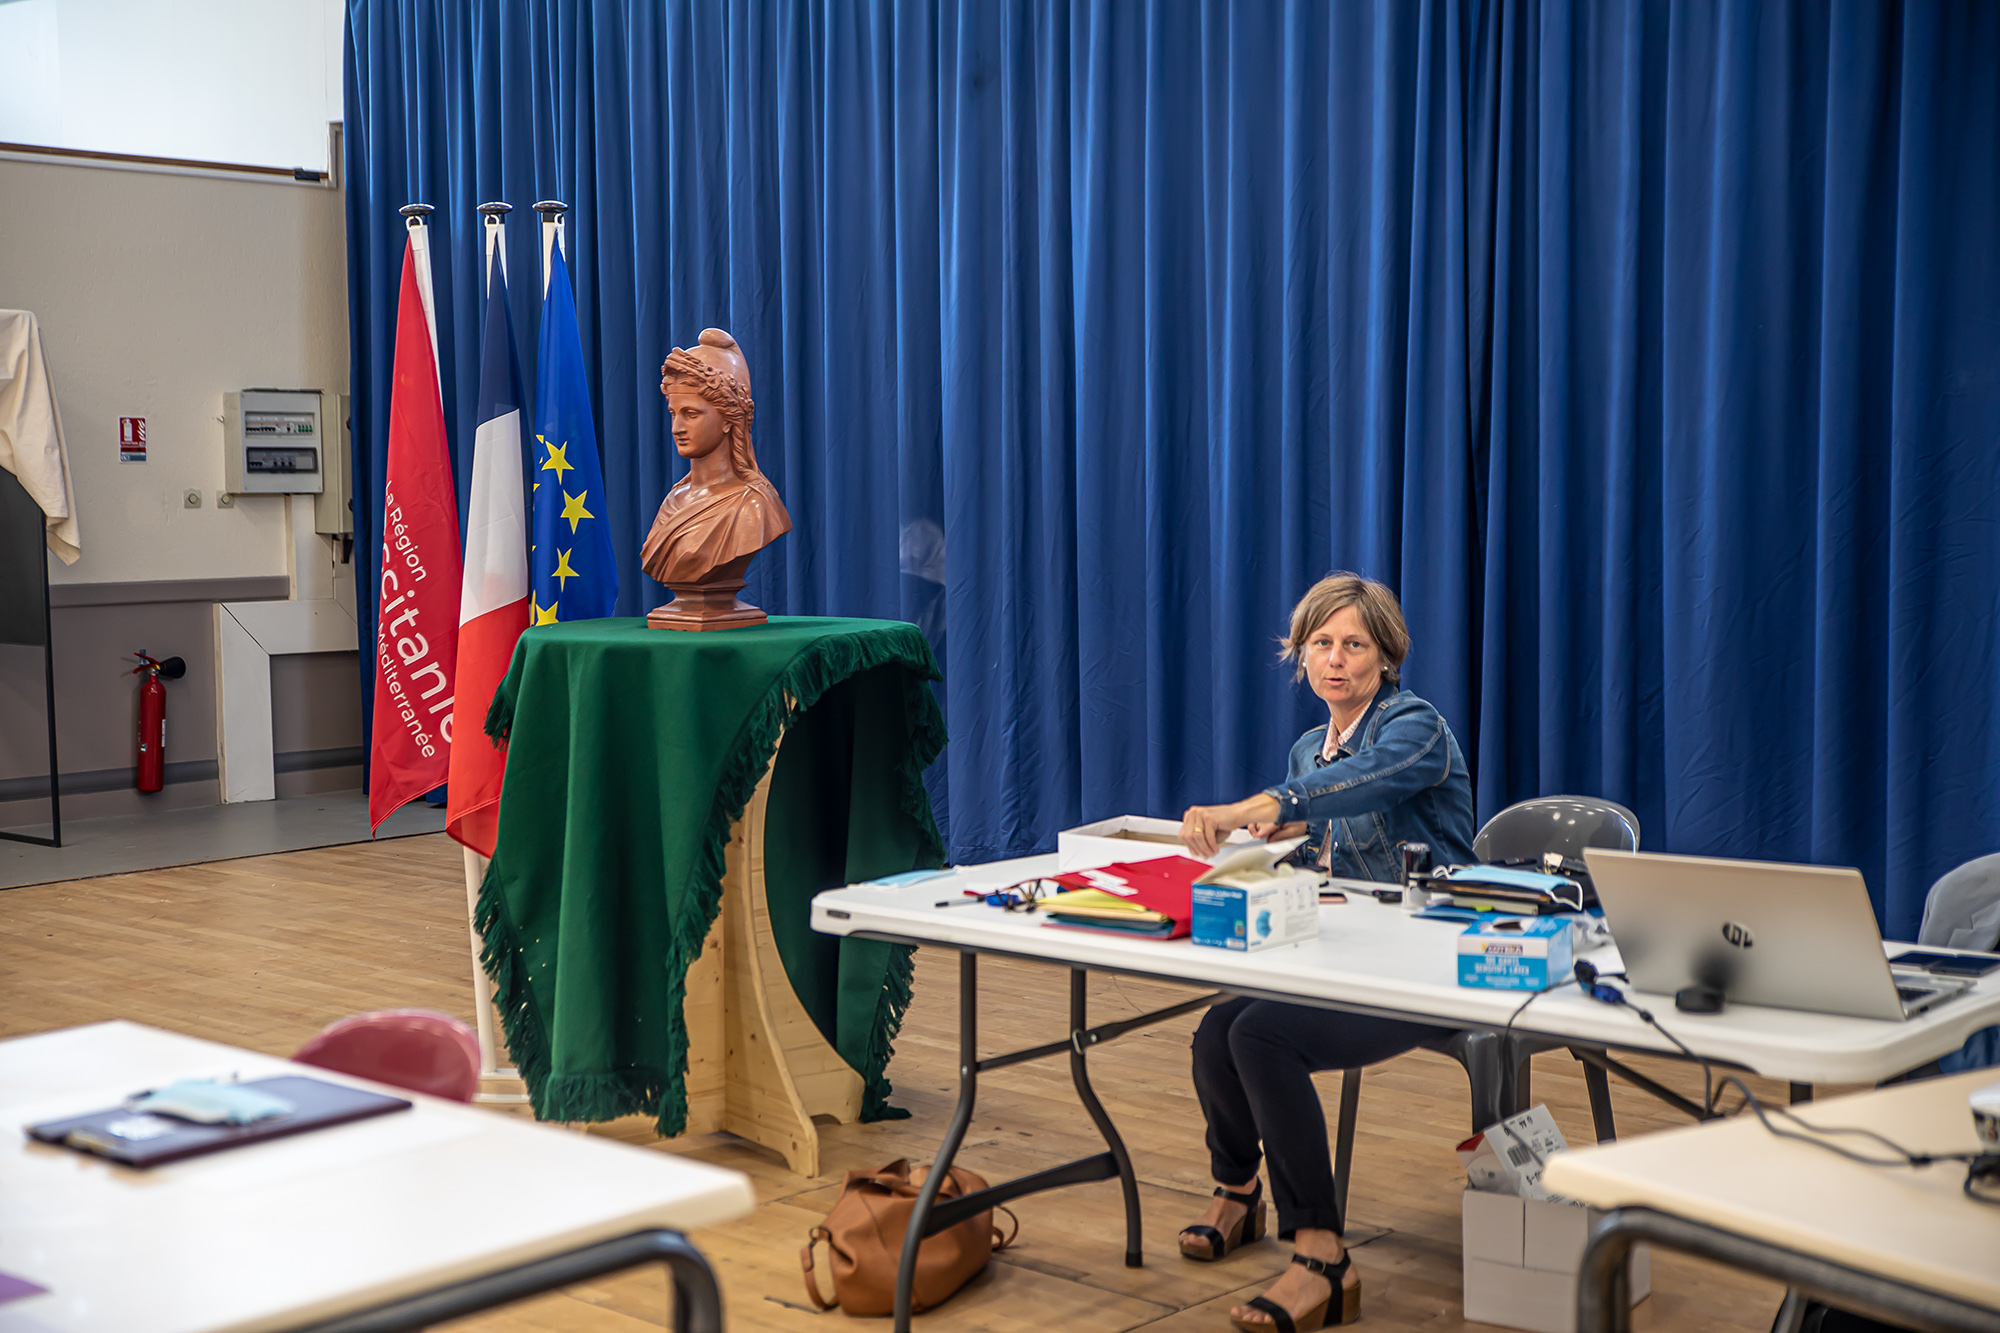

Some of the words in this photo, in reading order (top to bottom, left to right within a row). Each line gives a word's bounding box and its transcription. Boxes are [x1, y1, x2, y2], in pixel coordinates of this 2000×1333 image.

[390, 507, 427, 582] Région
[377, 622, 436, 758] Méditerranée
[381, 500, 455, 744] citani
